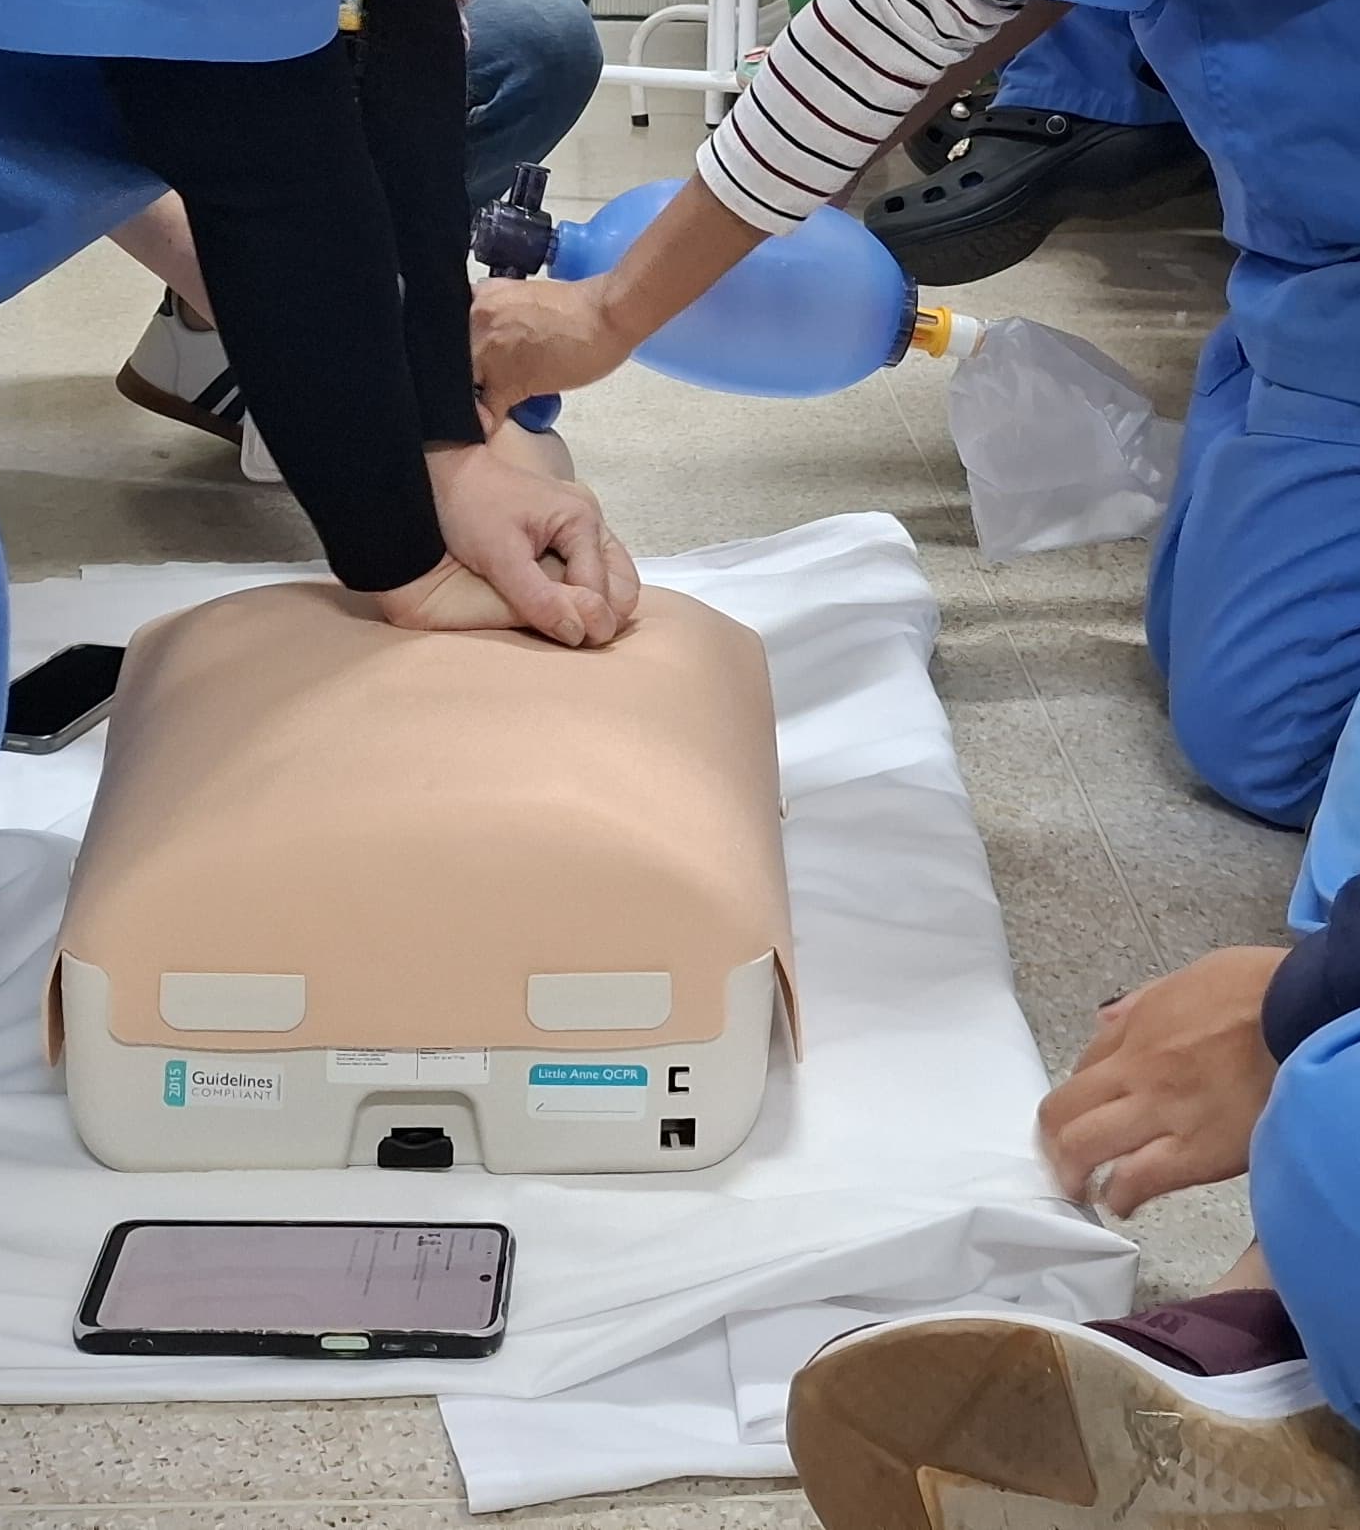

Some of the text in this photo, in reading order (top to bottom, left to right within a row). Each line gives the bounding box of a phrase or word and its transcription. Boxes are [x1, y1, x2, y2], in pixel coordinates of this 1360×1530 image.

[192, 1071, 273, 1089] Guidelines
[538, 1068, 639, 1081] Little Anne QCPR
[168, 1067, 181, 1098] 2015
[191, 1087, 272, 1100] COMPLIANT
